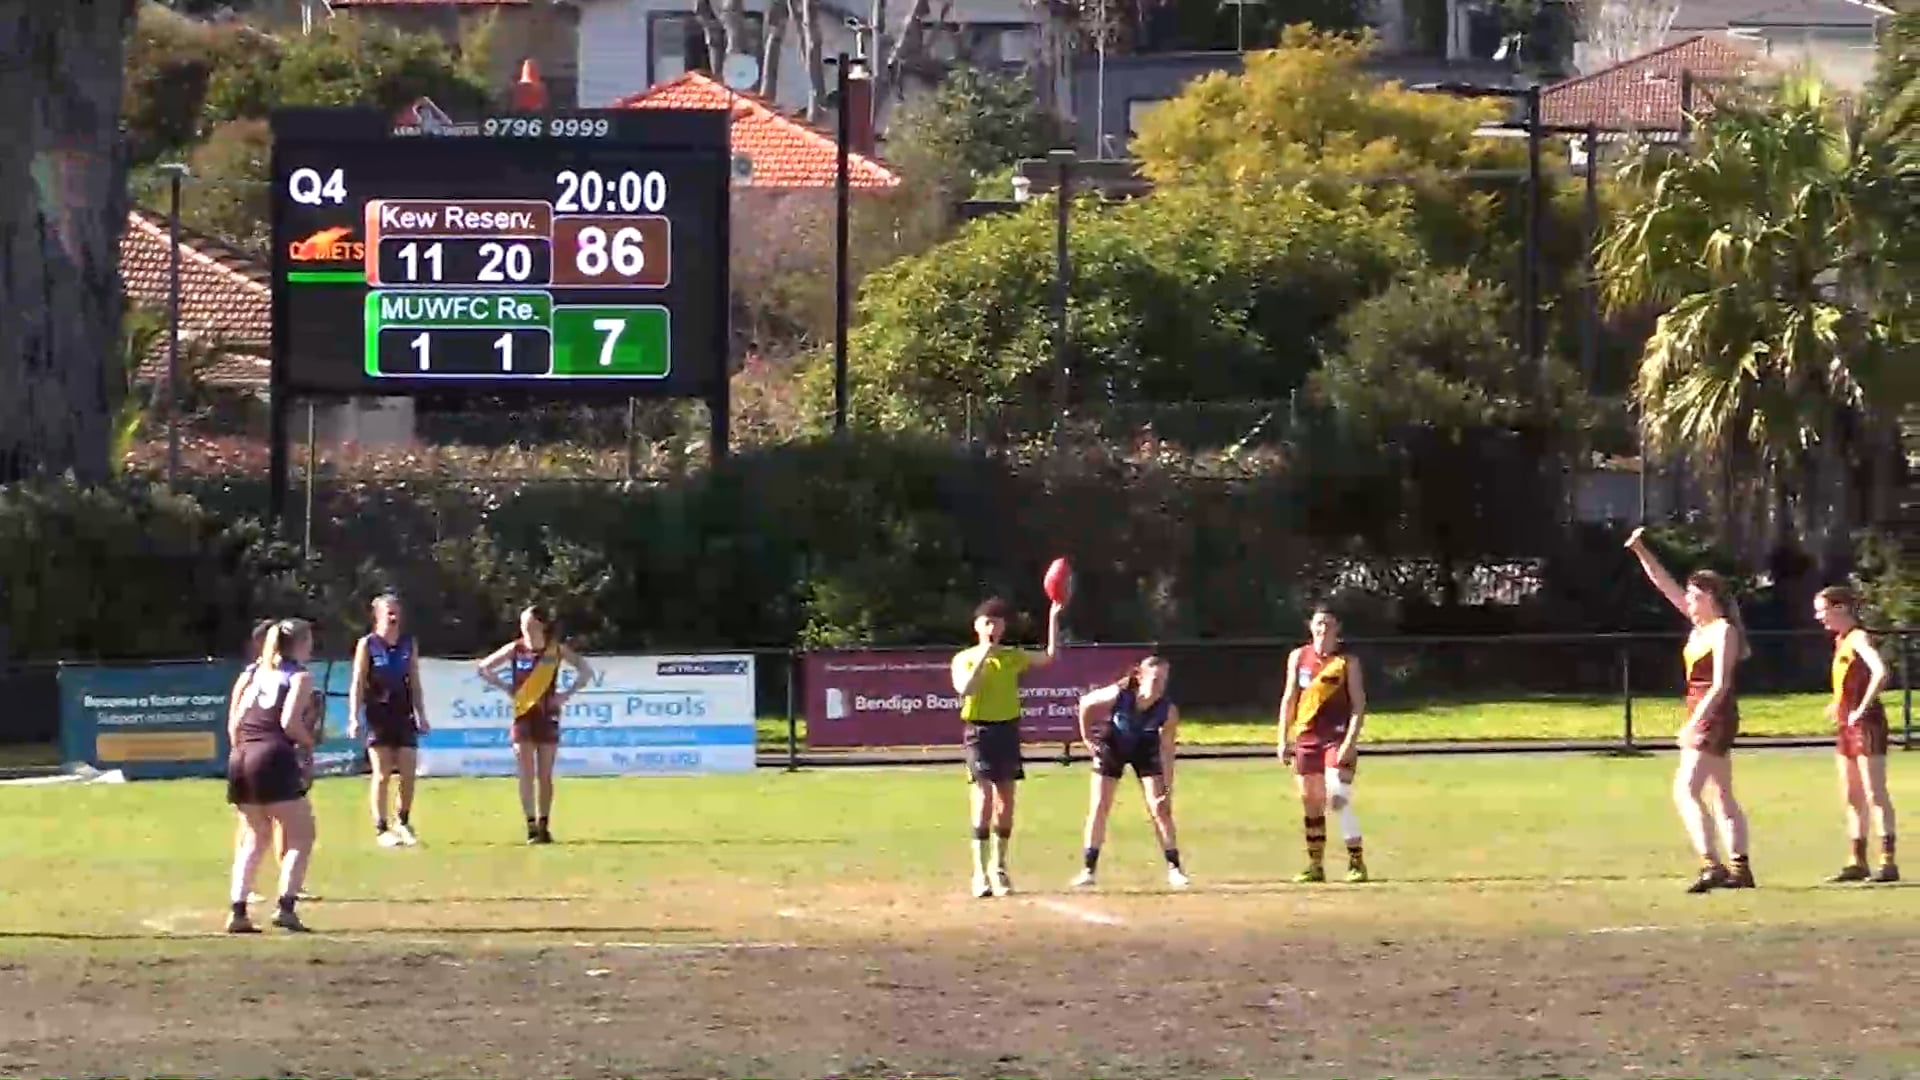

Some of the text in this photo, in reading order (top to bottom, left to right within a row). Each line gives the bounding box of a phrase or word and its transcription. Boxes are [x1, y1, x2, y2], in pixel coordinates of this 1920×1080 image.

[483, 118, 542, 137] 9796
[550, 118, 609, 137] 9999
[289, 168, 348, 205] Q4
[555, 170, 667, 213] 20:00
[381, 206, 536, 229] Kew Reserv.
[398, 242, 532, 281] 11 20
[575, 226, 645, 276] 86
[381, 297, 540, 320] MUWFC Re.
[411, 332, 514, 371] 1 1
[593, 319, 626, 367] 7
[84, 695, 138, 708] Become
[149, 694, 190, 706] foster
[627, 696, 706, 716] Pools
[855, 695, 922, 714] Bendigo
